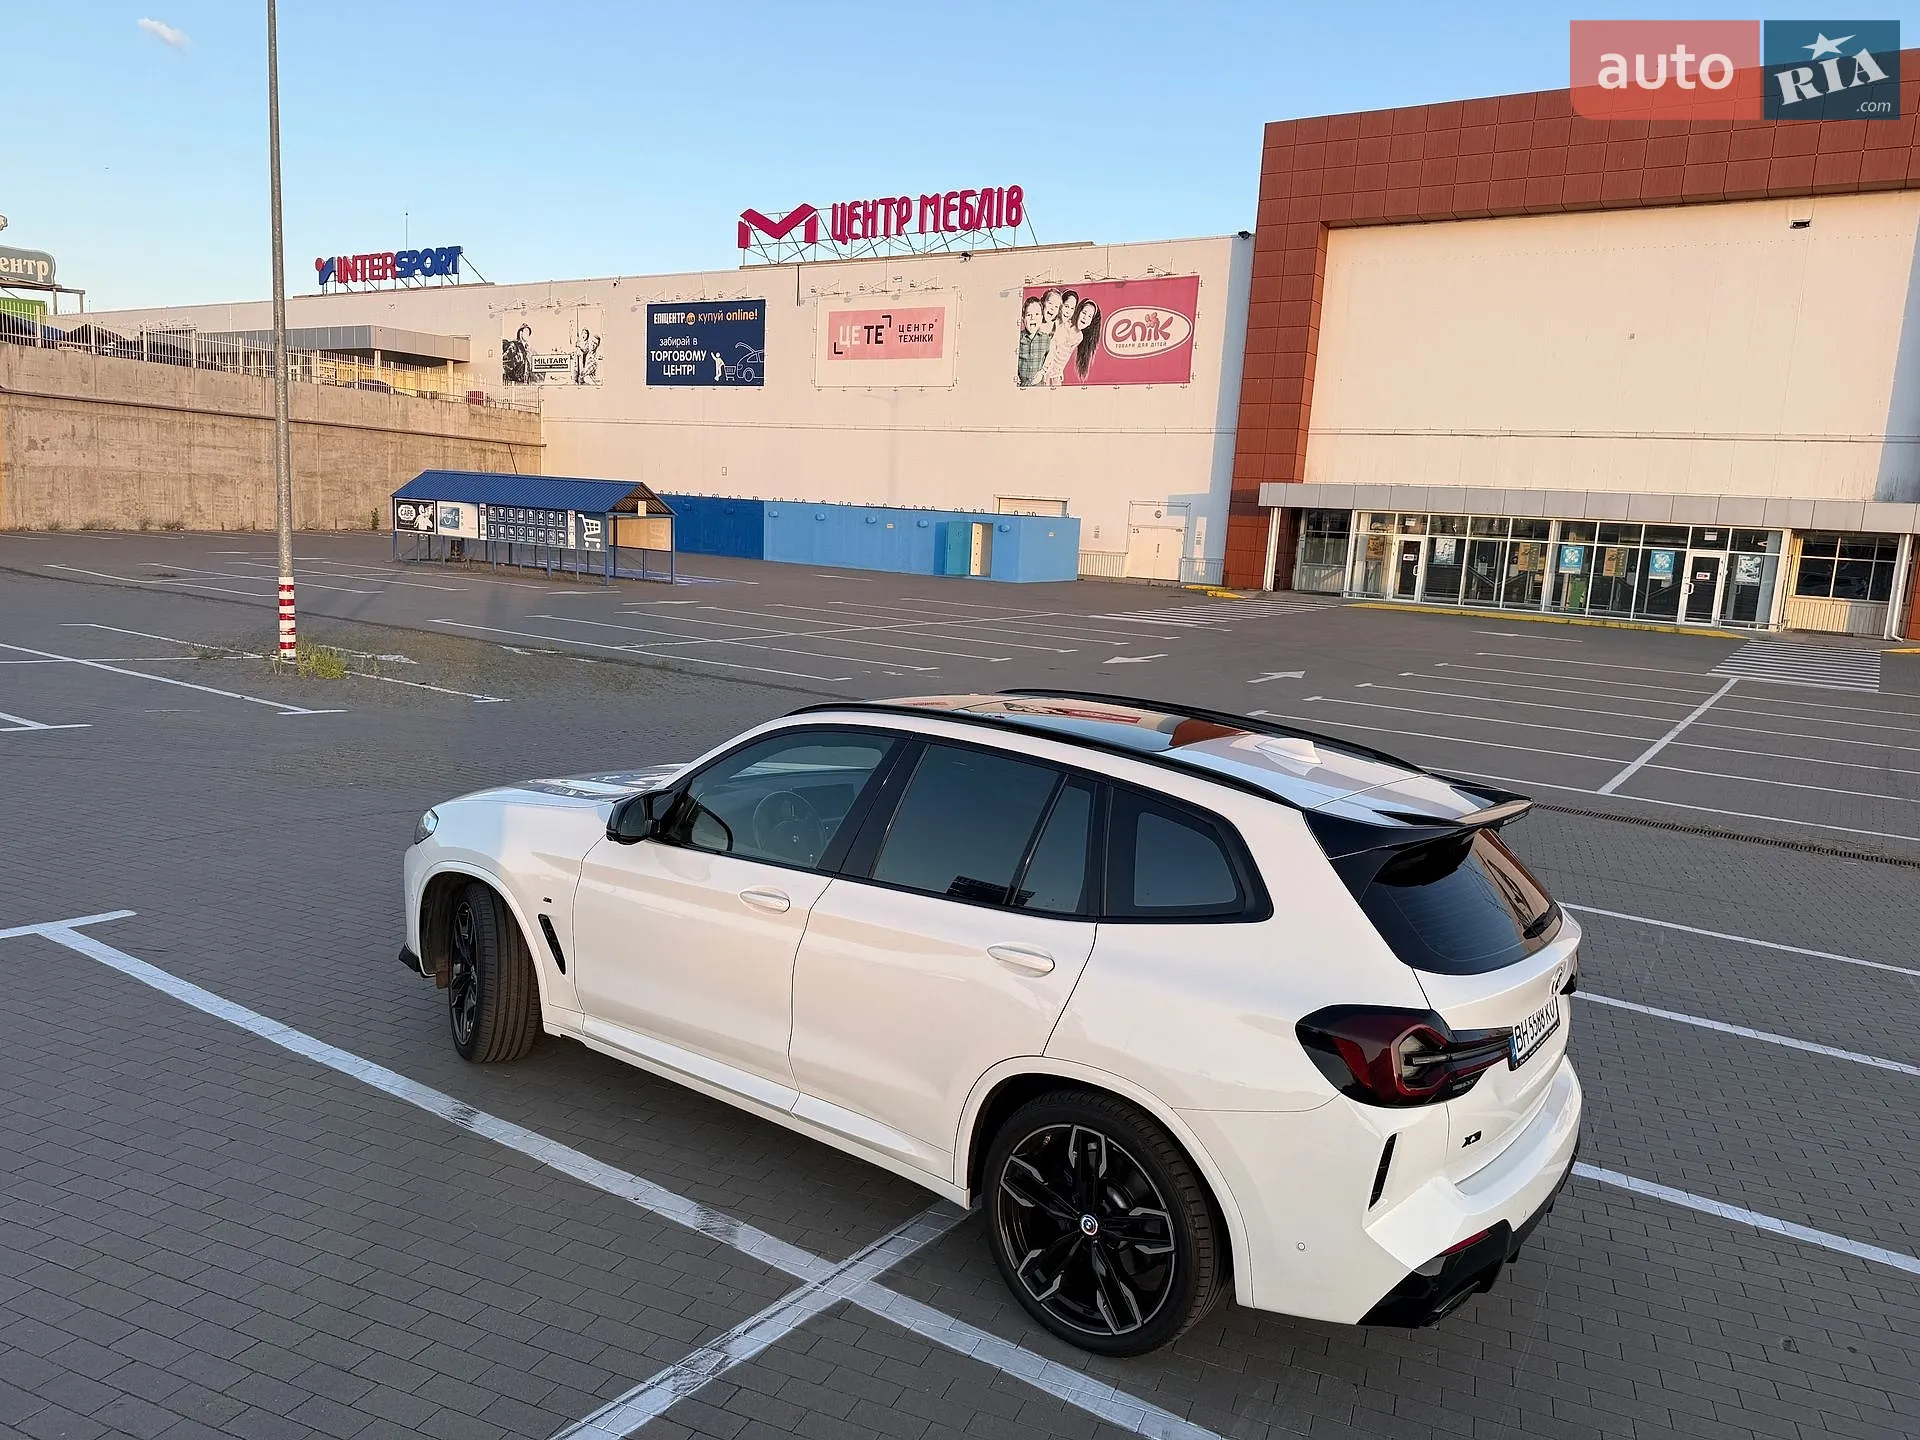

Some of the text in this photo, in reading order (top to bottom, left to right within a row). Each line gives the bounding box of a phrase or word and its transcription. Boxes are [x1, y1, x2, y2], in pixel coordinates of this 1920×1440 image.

[832, 196, 913, 245] ЦЕНТР
[918, 184, 1024, 234] МЕБЛІВ
[336, 246, 463, 284] INTERSPORT
[698, 310, 724, 324] купуй
[726, 308, 758, 321] online!
[898, 323, 935, 333] ЦЕНТР
[659, 336, 698, 348] забирай в
[898, 334, 934, 344] ТЕХНІКИ
[650, 349, 707, 362] ТОРГОВОМУ
[663, 364, 696, 378] ЦЕНТРІ
[1461, 1129, 1482, 1148] X3
